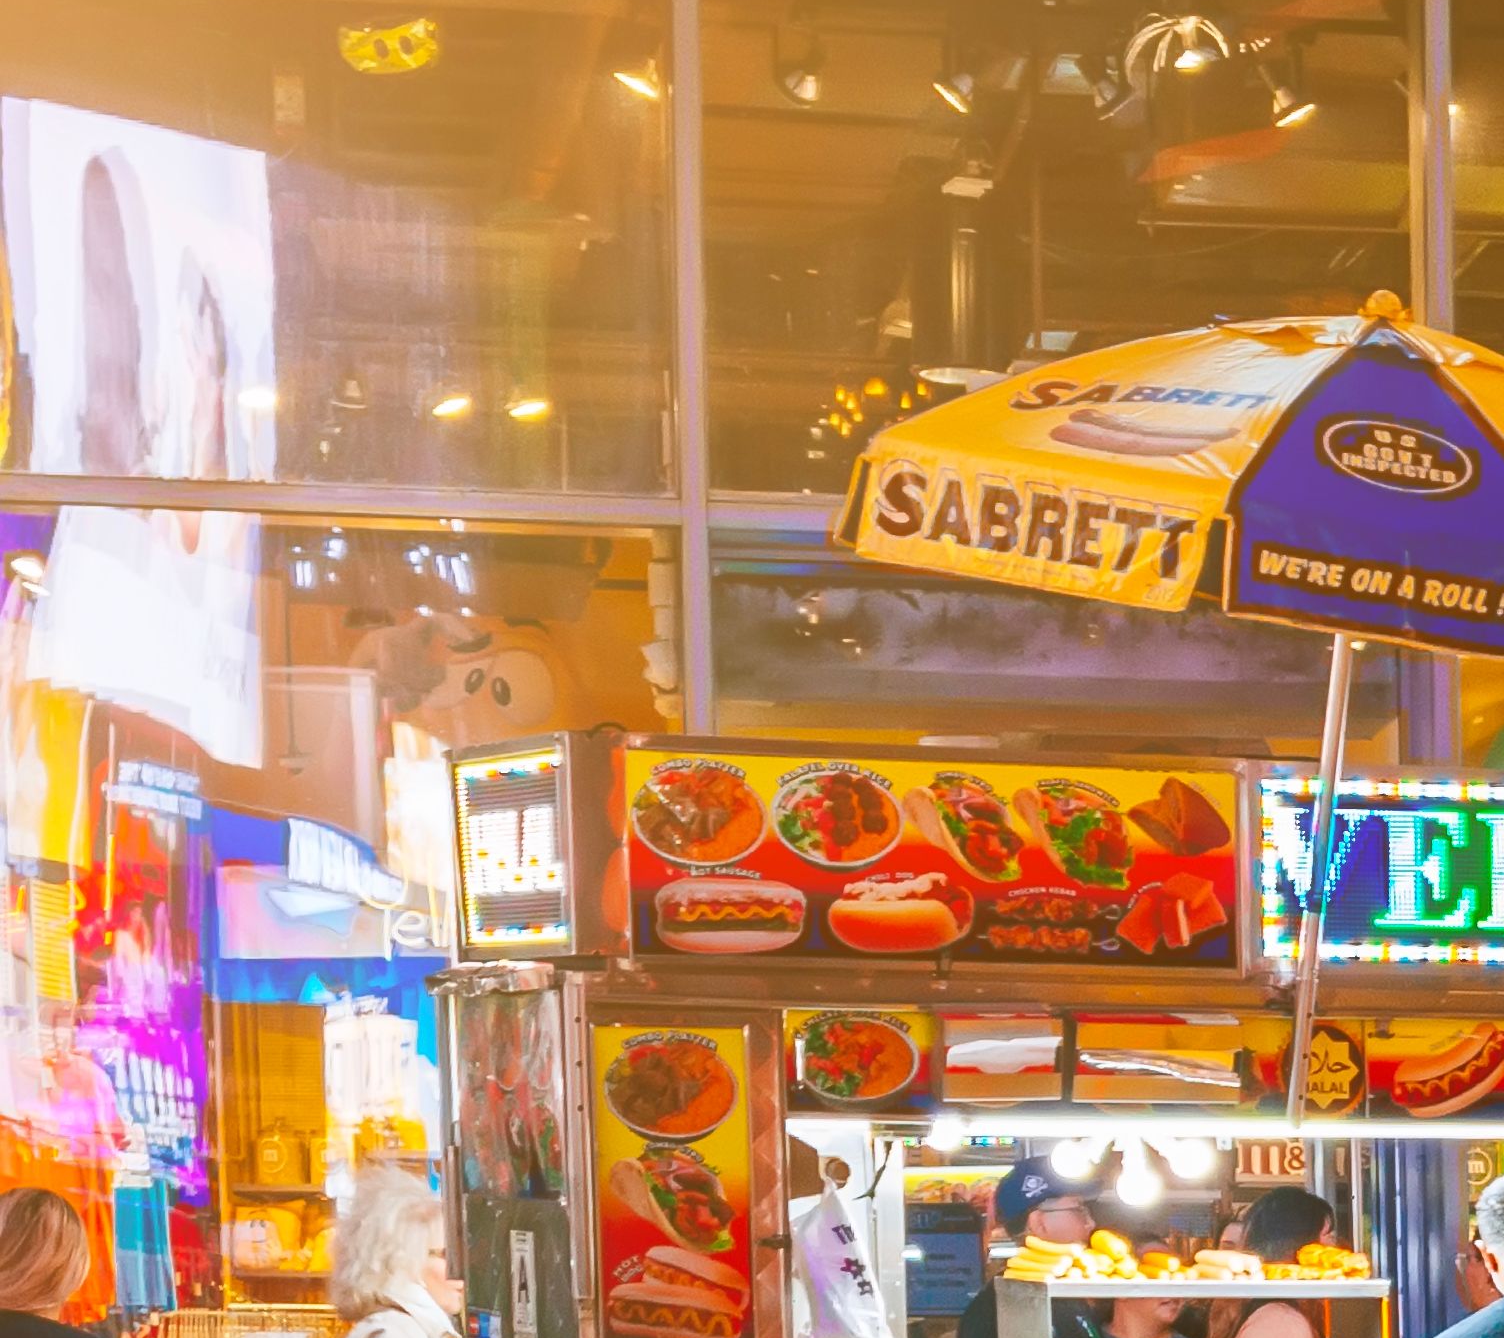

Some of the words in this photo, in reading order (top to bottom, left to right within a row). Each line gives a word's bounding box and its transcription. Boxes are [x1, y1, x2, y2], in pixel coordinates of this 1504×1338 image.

[1010, 379, 1275, 411] SABRETT
[1341, 452, 1457, 484] INSPECTED
[875, 461, 1200, 580] SABRETT
[1258, 549, 1346, 588] WE'RE
[1350, 568, 1393, 596] ON
[1397, 574, 1416, 600] A
[1422, 579, 1489, 614] ROLL
